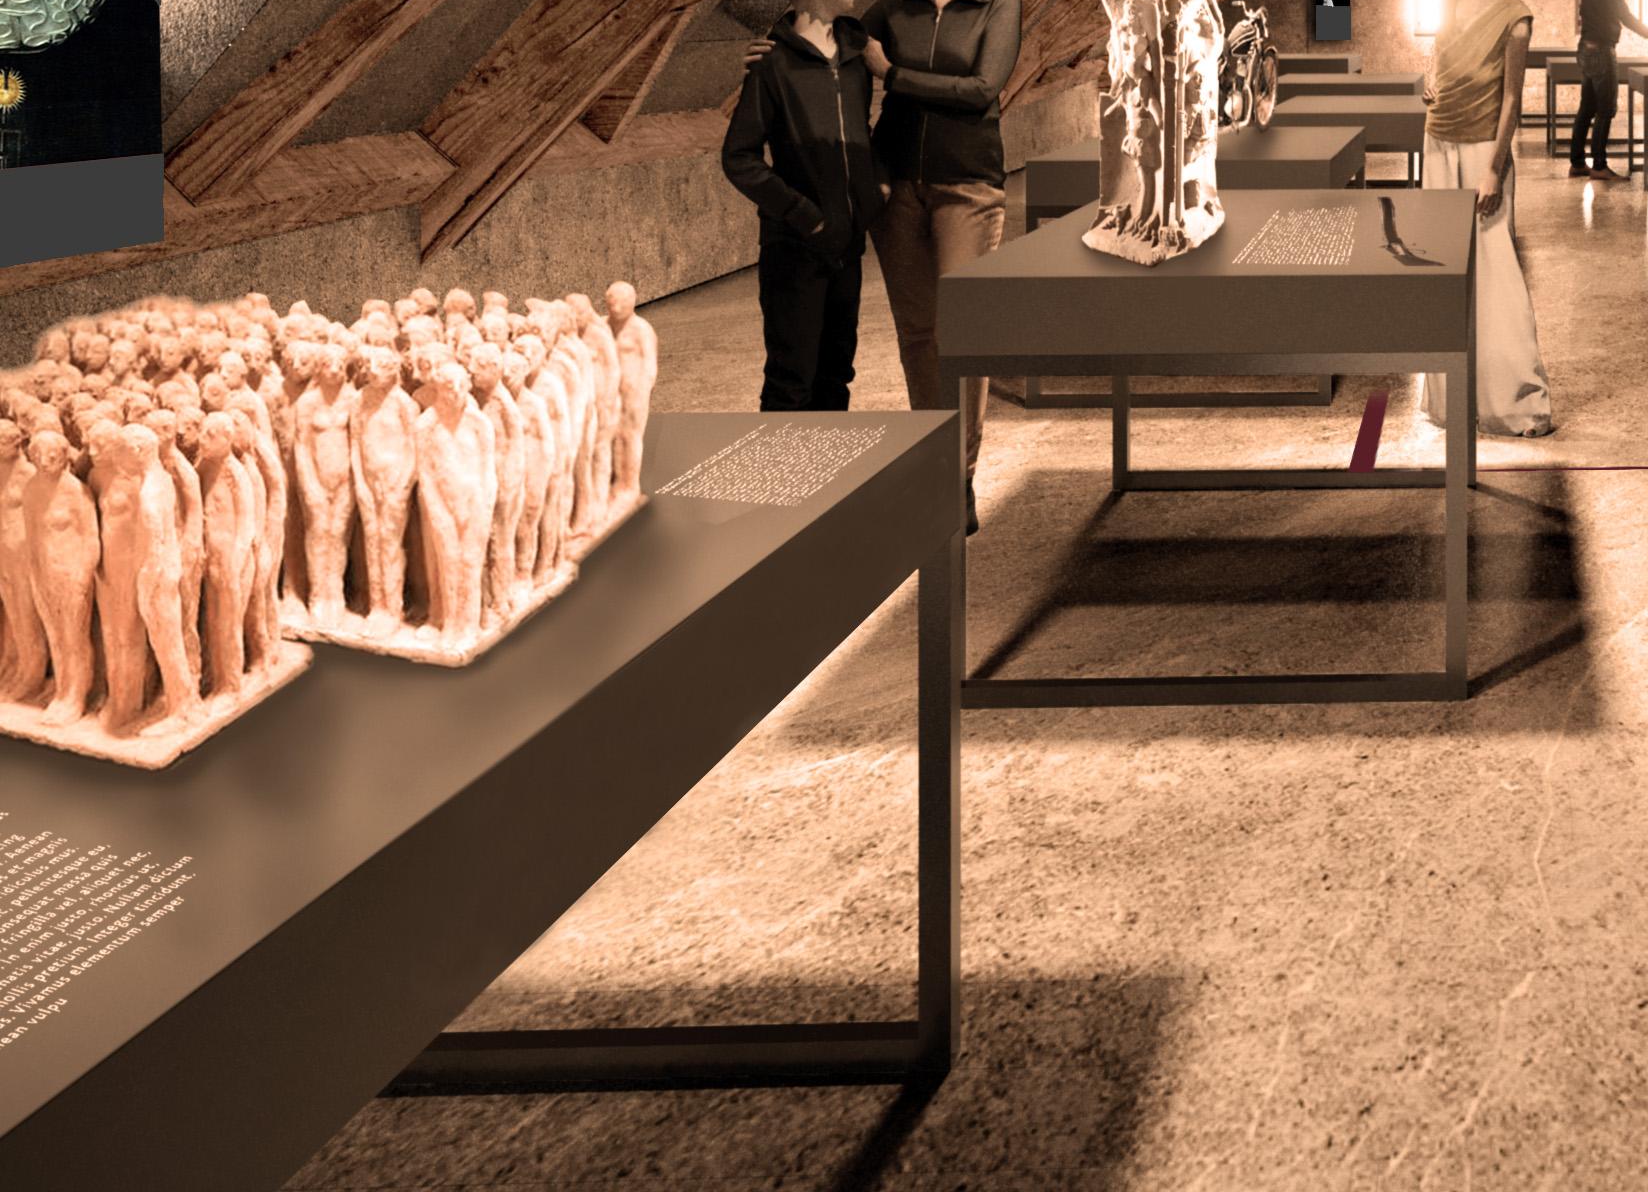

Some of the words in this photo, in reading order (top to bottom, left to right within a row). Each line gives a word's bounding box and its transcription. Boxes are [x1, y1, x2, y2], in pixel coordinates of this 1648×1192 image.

[4, 831, 53, 859] Aenean
[53, 871, 92, 896] massa
[90, 854, 118, 871] quis
[102, 883, 152, 914] Nullam
[149, 855, 193, 882] dictum
[19, 931, 55, 954] enim
[89, 874, 140, 906] rhoncus
[86, 911, 135, 943] Integer
[8, 975, 71, 1014] Vivamus
[69, 926, 142, 976] elementum
[139, 895, 185, 926] semper
[26, 998, 68, 1025] vulpu
